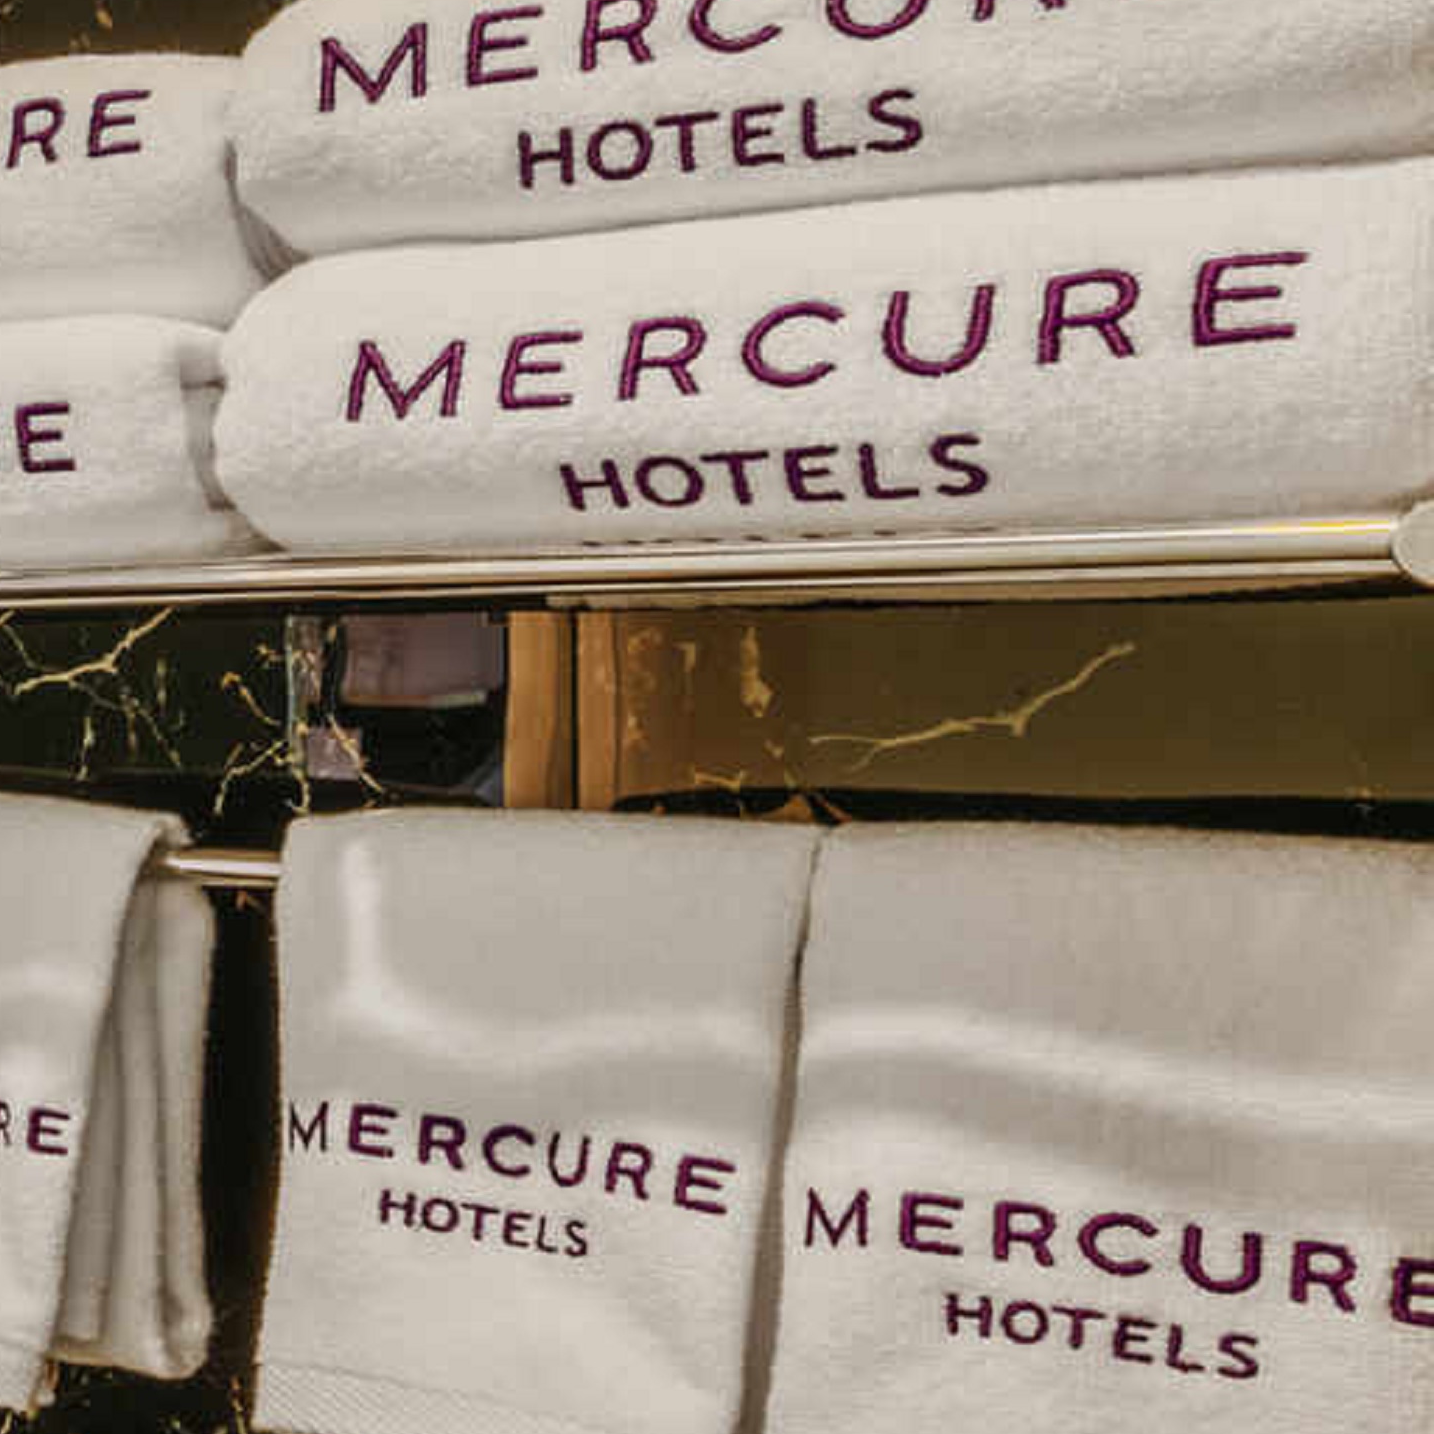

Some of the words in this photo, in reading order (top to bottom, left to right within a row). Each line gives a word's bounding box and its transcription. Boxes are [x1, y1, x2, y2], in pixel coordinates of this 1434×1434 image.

[515, 86, 924, 190] HOTELS
[345, 250, 1308, 422] MERCURE
[559, 432, 990, 512] HOTELS
[287, 1100, 736, 1216] MERCURE
[377, 1185, 589, 1258] HOTELS
[803, 1186, 1434, 1329] MERCURE
[944, 1292, 1260, 1380] HOTELS
